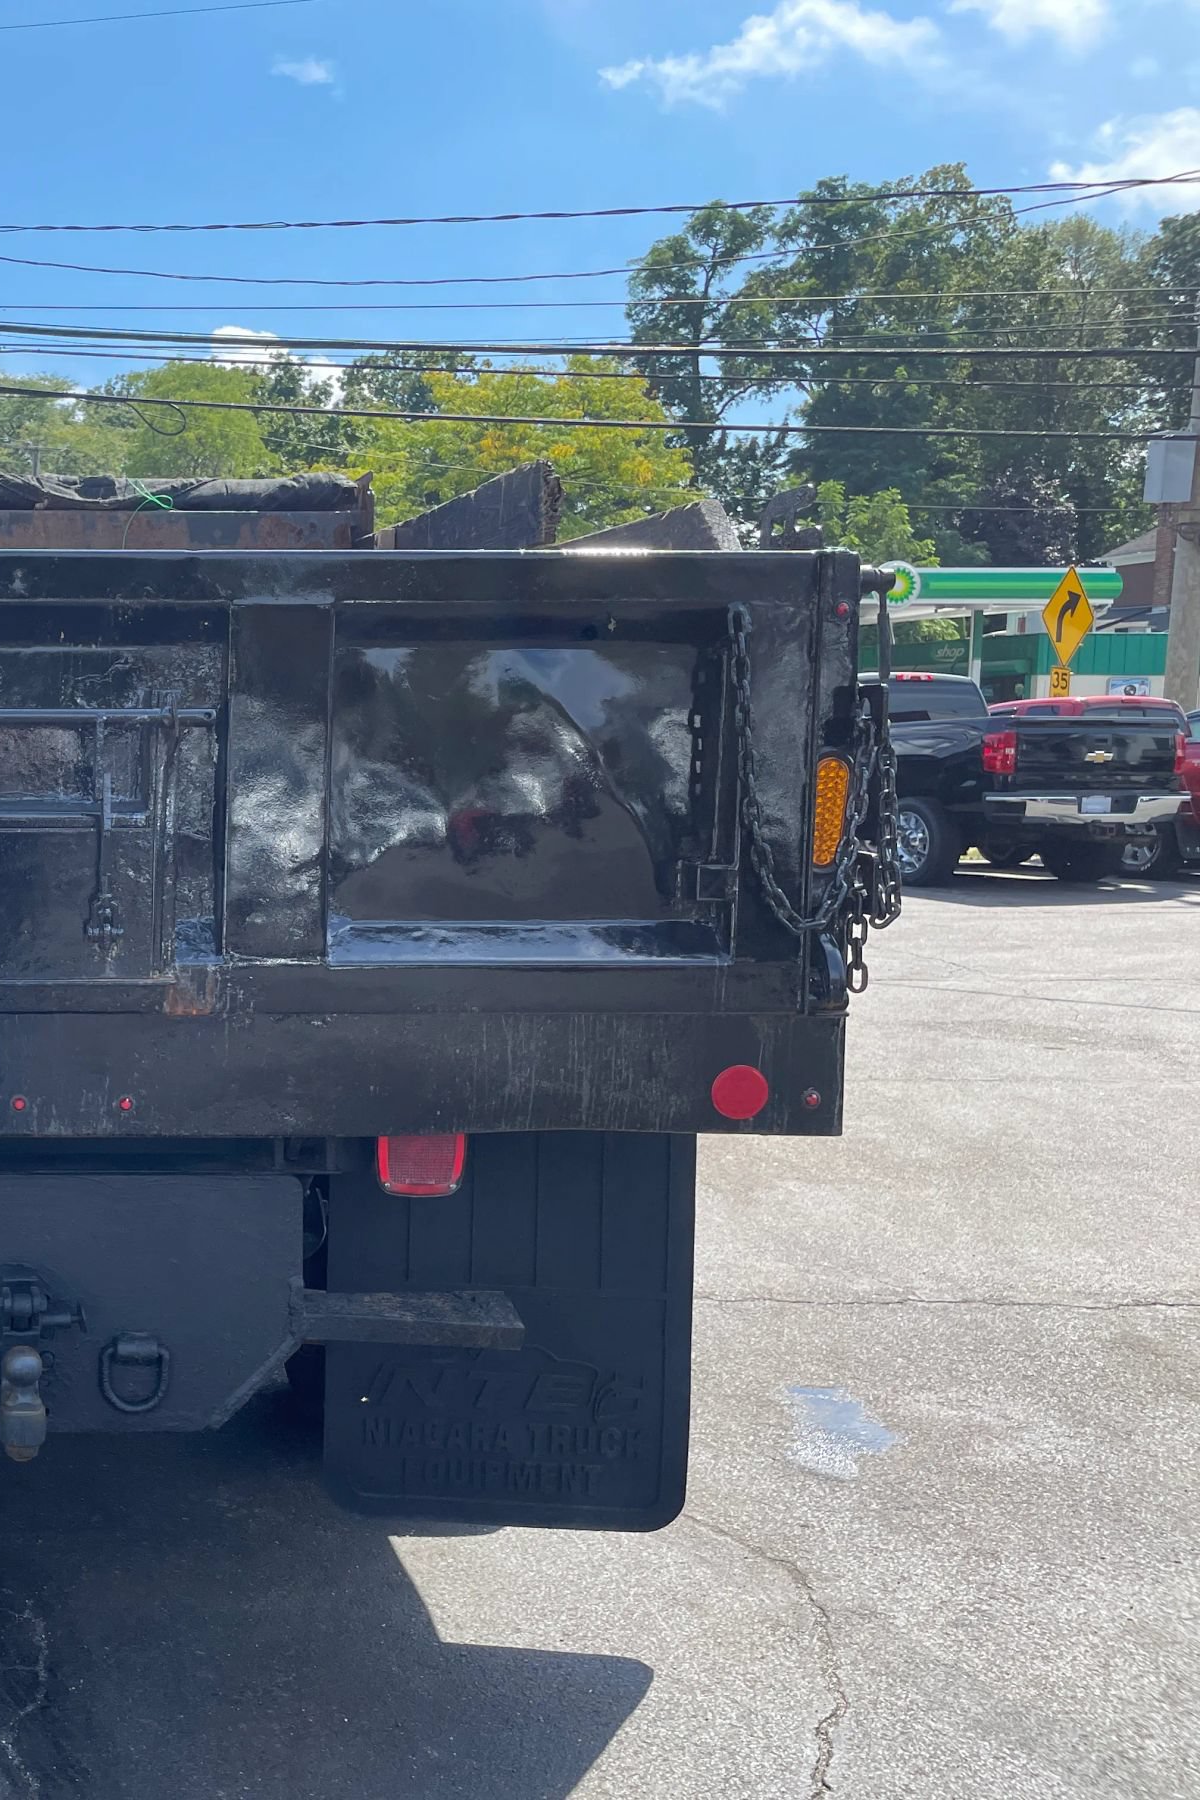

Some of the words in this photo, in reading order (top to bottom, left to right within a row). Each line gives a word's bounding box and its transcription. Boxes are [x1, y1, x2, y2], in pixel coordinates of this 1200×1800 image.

[936, 644, 965, 661] shop
[1052, 672, 1068, 689] 35
[362, 1416, 509, 1453] NIAGARA
[527, 1423, 642, 1460] TRUCK
[402, 1457, 603, 1496] EQUIPMENT
